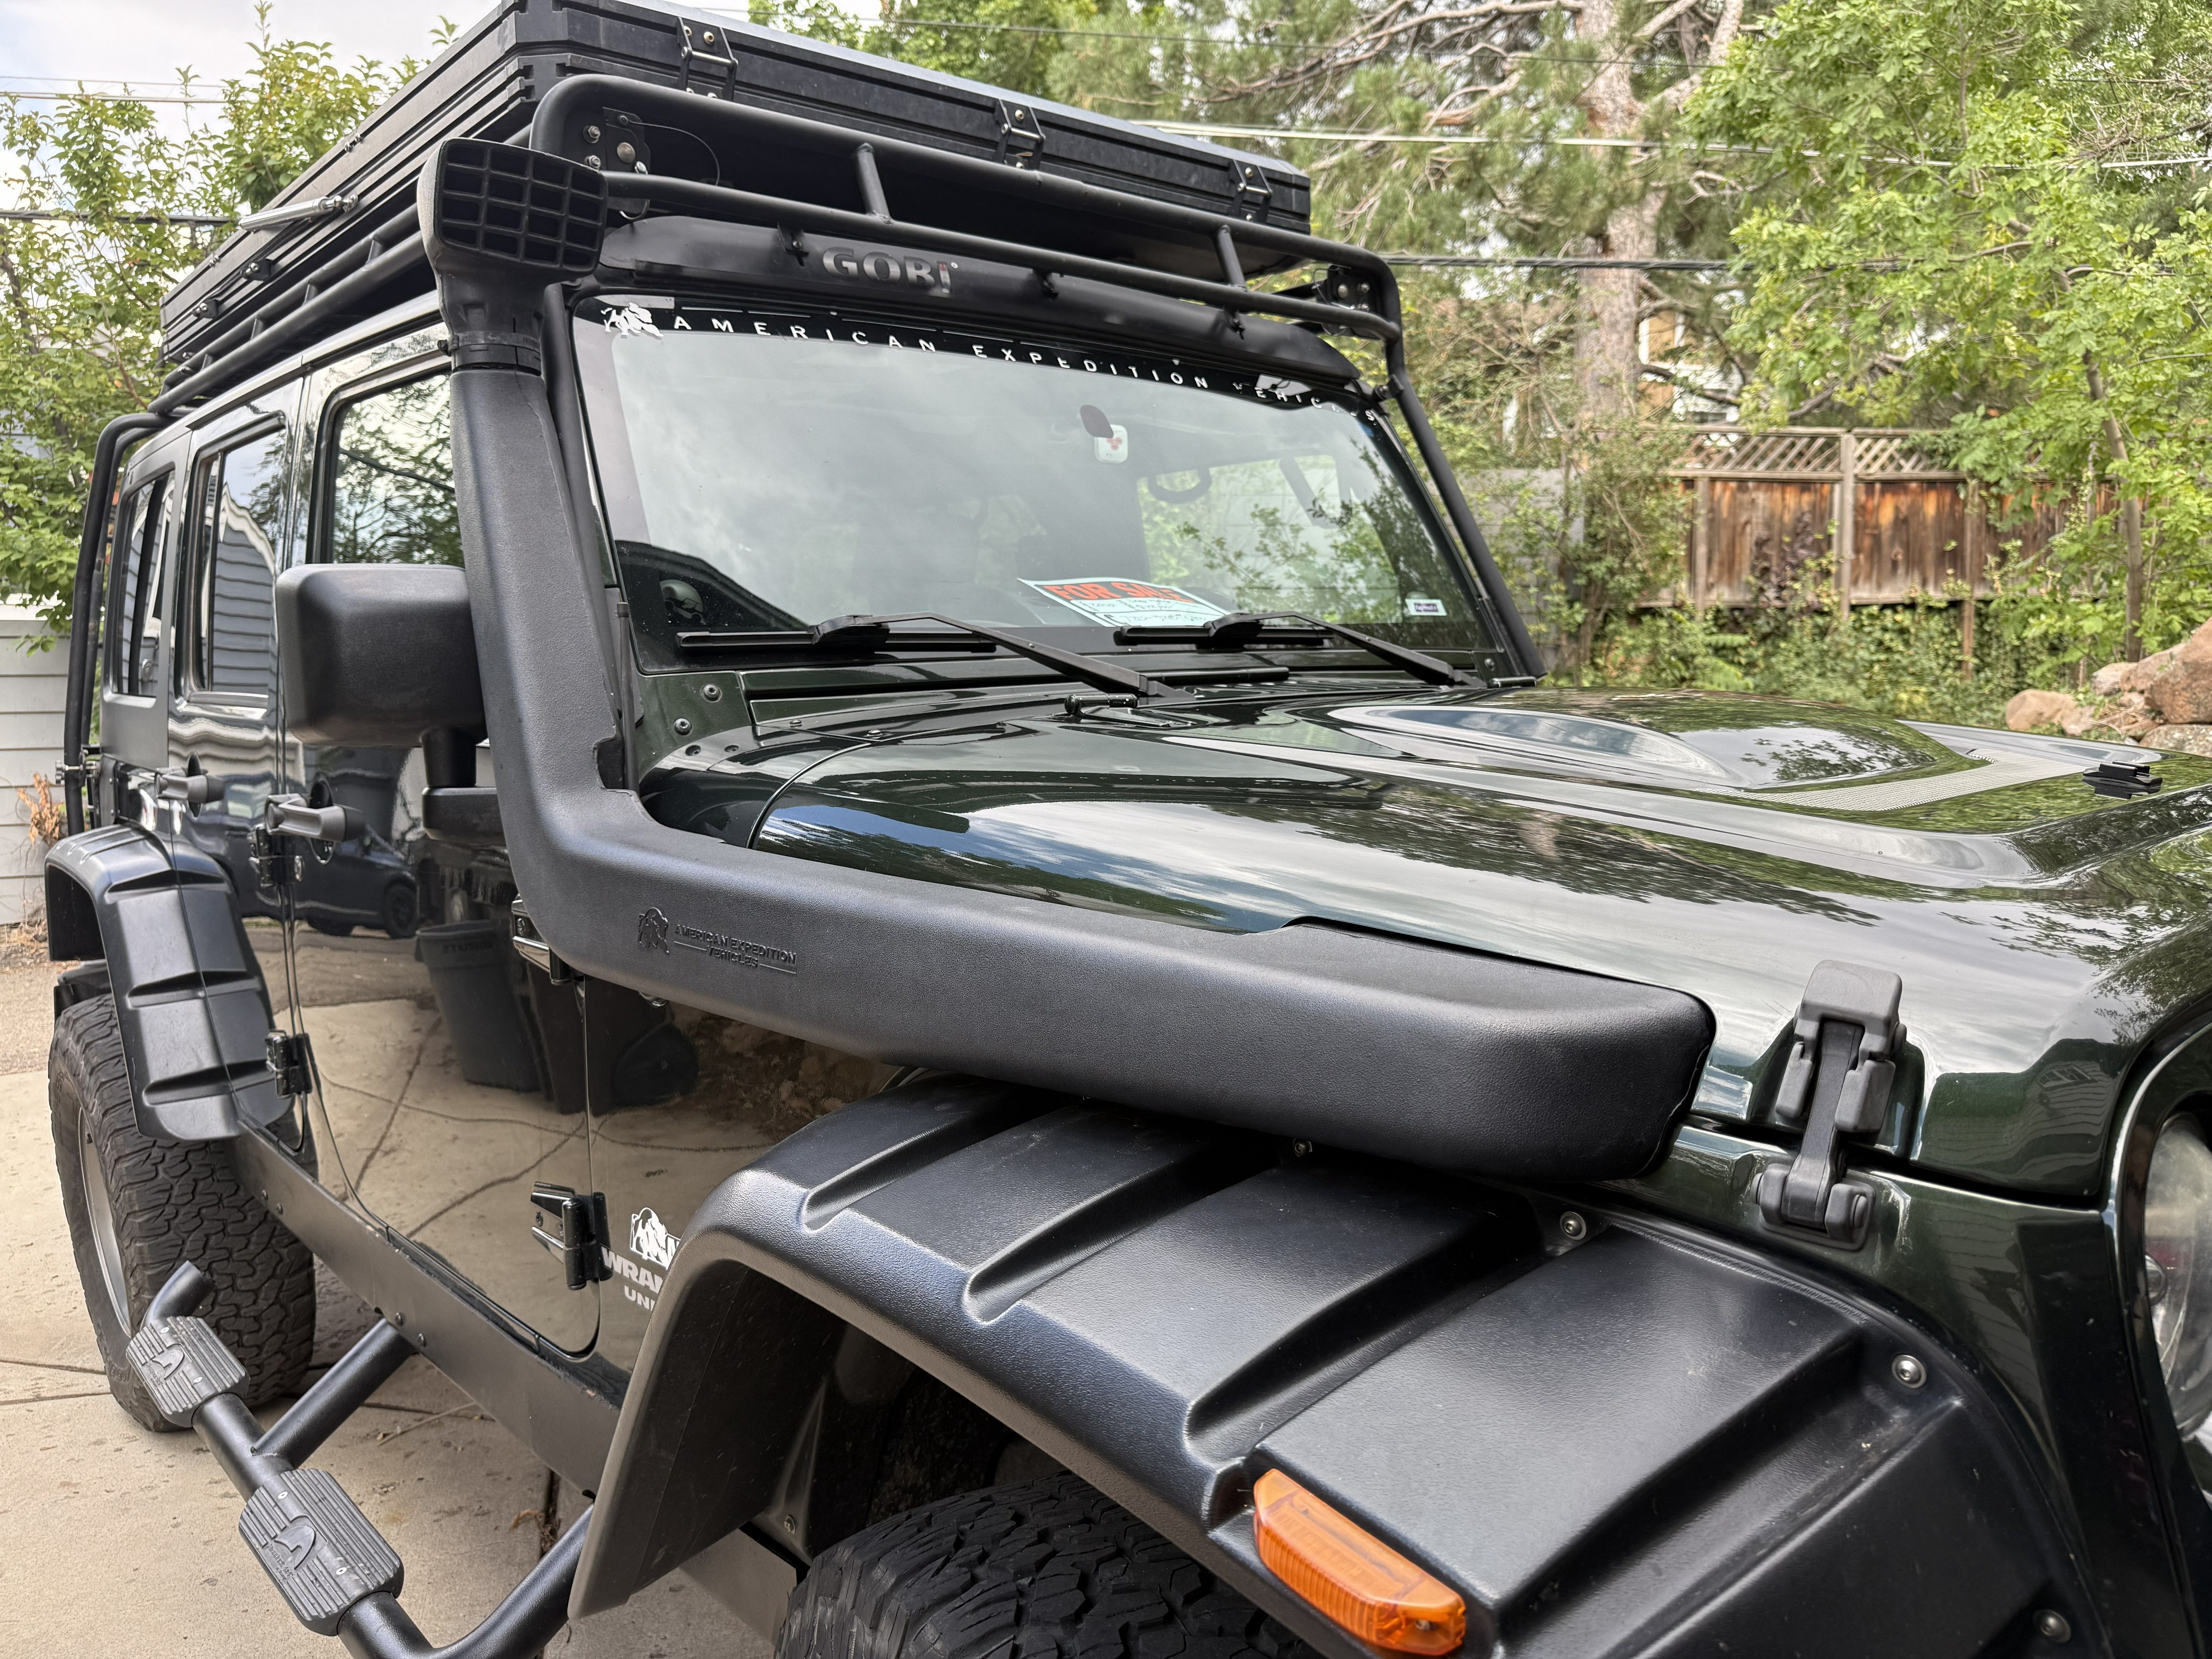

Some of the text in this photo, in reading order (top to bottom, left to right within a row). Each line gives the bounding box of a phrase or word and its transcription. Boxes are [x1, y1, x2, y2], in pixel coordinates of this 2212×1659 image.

[823, 246, 951, 294] GOBI
[674, 316, 935, 352] AMERICAN
[972, 344, 1208, 389] EXPEDITION
[1044, 582, 1194, 603] FOR SALE
[675, 924, 796, 964] AMERICAN EXPEDITION
[707, 945, 758, 968] VEHICLES
